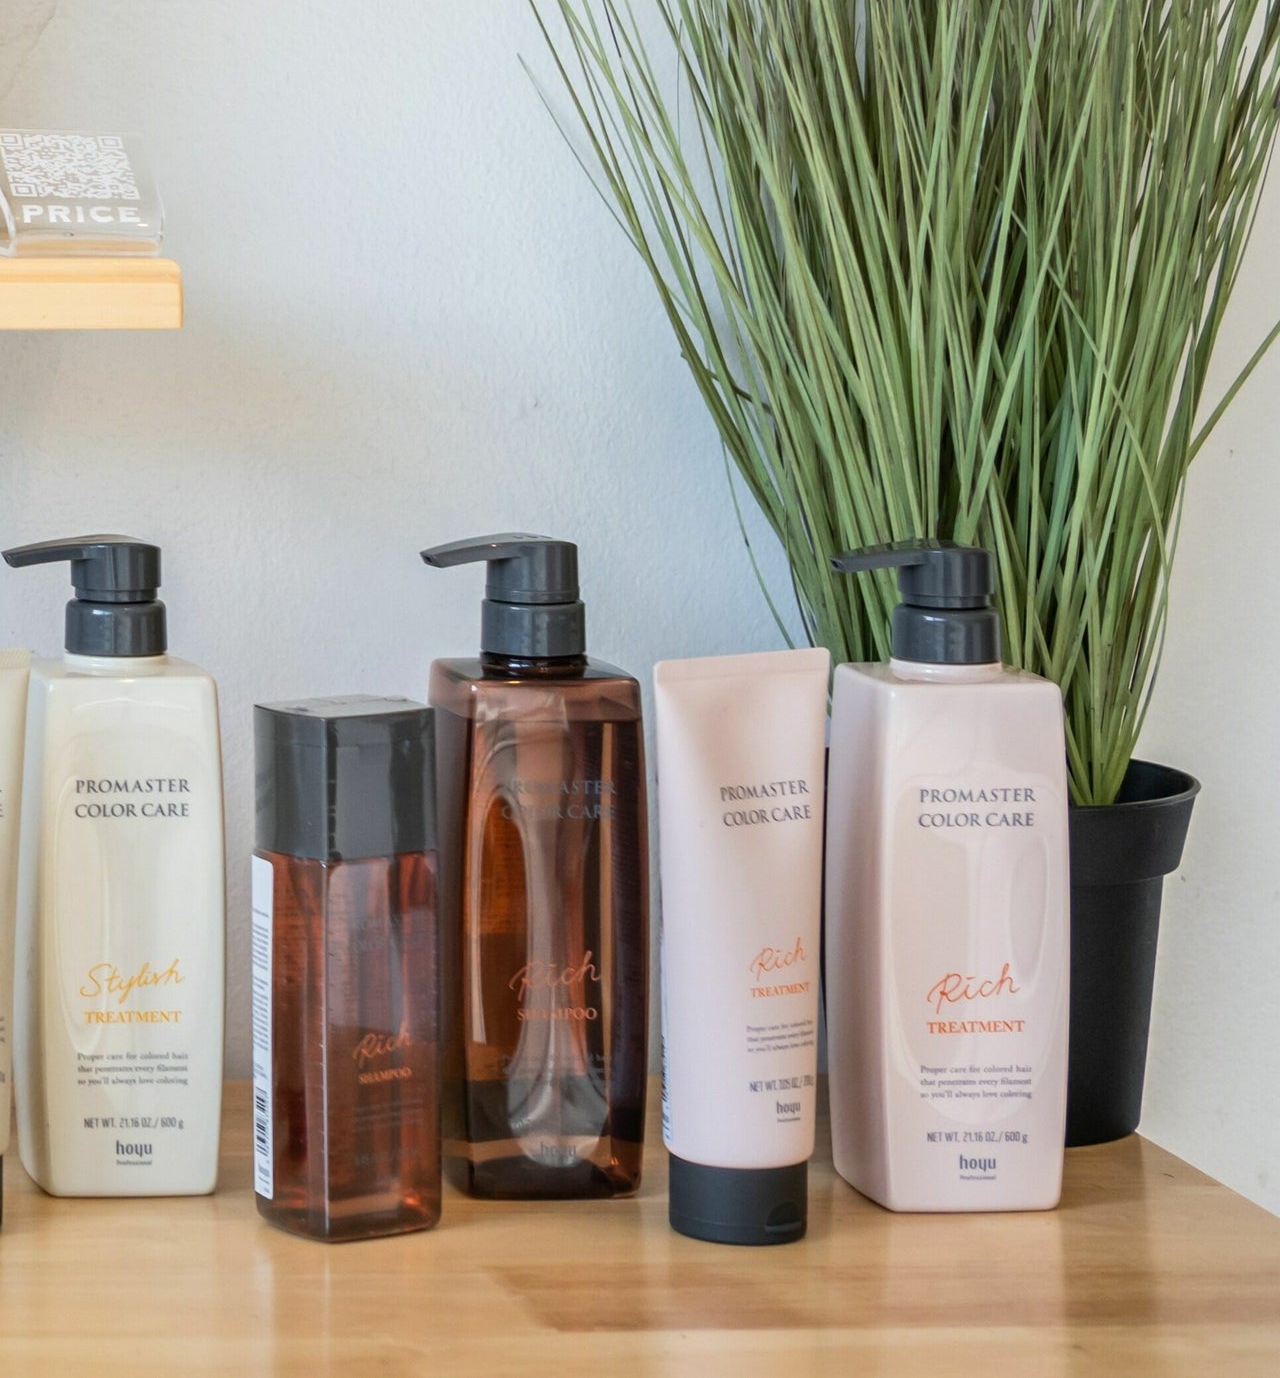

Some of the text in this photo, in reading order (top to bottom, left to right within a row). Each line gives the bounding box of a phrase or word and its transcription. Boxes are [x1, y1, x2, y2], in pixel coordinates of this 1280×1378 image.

[21, 204, 141, 224] PRICE
[75, 778, 191, 794] PROMASTER
[719, 779, 809, 802] PROMASTER
[919, 788, 1036, 804] PROMASTER
[75, 803, 190, 818] COLOR CARE
[723, 803, 811, 827] COLOR CARE
[918, 812, 1034, 828] COLOR CARE
[749, 936, 807, 981] Rich
[80, 957, 185, 1005] Stylish
[508, 950, 601, 1002] Rich
[750, 982, 811, 998] TREATMENT
[927, 963, 1020, 1015] Rich
[84, 1010, 182, 1024] TREATMENT
[517, 1007, 597, 1022] SHAMPOO
[927, 1020, 1025, 1035] TREATMENT
[77, 1052, 104, 1062] Proper
[920, 1065, 947, 1075] Proper
[984, 1065, 1013, 1073] colored
[1016, 1065, 1032, 1073] hair
[978, 1079, 998, 1088] every
[955, 1090, 1032, 1100] always coloring
[776, 1101, 801, 1114] hoyu
[83, 1118, 99, 1128] NET
[927, 1132, 942, 1142] NET
[115, 1139, 152, 1158] hoyu
[959, 1153, 996, 1173] hoyu
